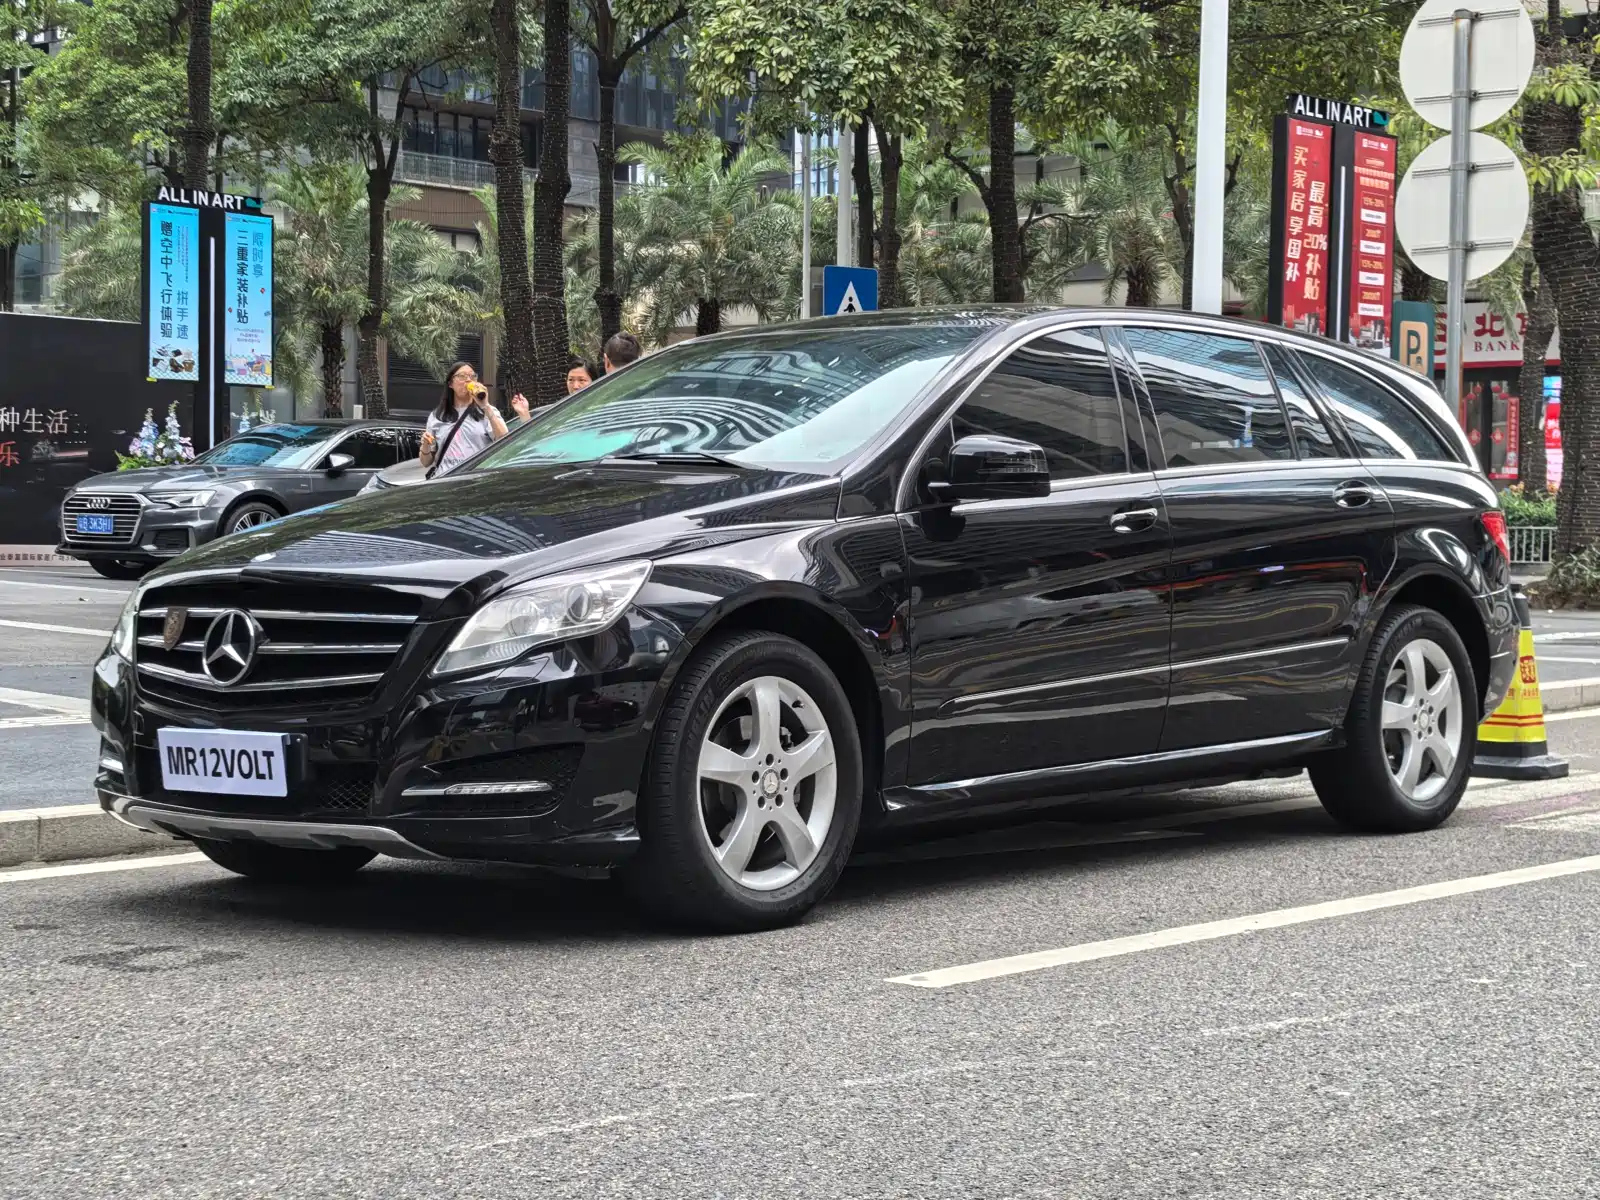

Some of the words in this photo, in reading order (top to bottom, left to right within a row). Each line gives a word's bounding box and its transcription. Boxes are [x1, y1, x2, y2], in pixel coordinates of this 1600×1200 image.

[1294, 95, 1323, 119] ALL
[1326, 100, 1340, 122] IN
[1343, 104, 1372, 128] ART
[158, 186, 190, 204] ALL
[193, 190, 209, 206] IN
[212, 193, 244, 210] ART
[1286, 145, 1309, 282] 买家居享国补
[1303, 180, 1328, 300] 最高20%补贴
[160, 220, 173, 339] 赠空中飞行体验
[236, 229, 249, 324] 三重家装补贴
[176, 289, 189, 340] 拼手速
[1407, 329, 1421, 366] P
[1474, 340, 1520, 353] BANK
[166, 745, 275, 780] MR12VOLT
